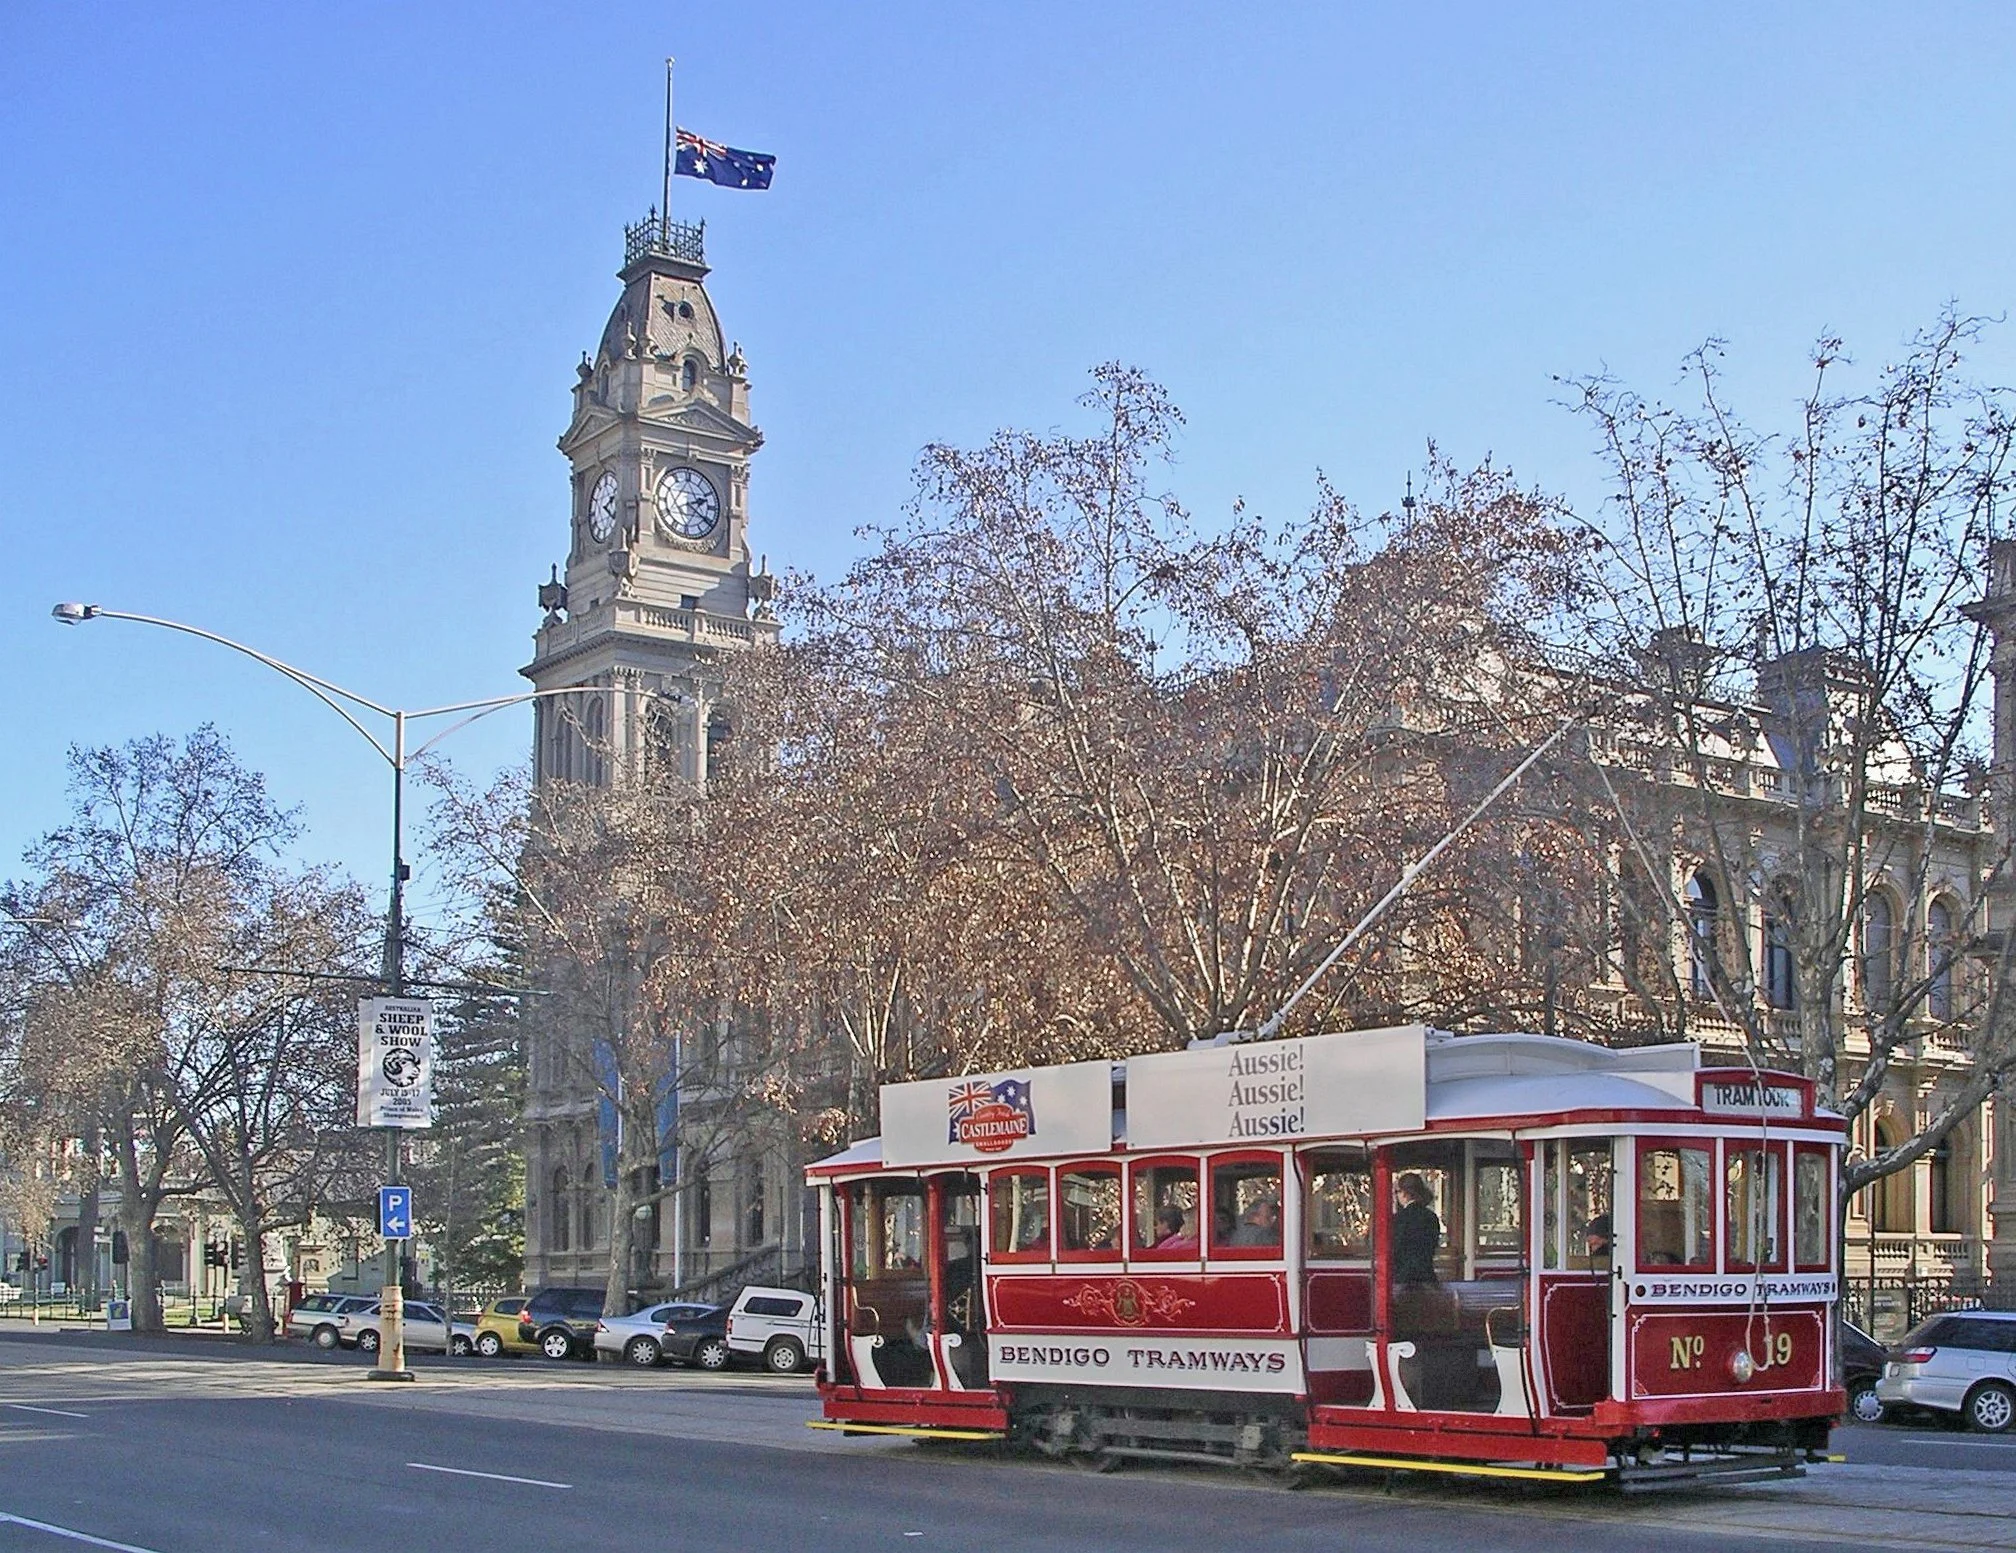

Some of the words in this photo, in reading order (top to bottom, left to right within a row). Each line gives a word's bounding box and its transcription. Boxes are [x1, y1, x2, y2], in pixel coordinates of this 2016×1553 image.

[379, 1013, 424, 1024] SHEEP
[375, 1024, 385, 1034] &
[388, 1025, 428, 1036] WOOL
[380, 1036, 422, 1047] SHOW
[1228, 1044, 1304, 1077] Aussie!
[380, 1088, 400, 1097] JULY
[1228, 1074, 1304, 1107] Aussie!
[961, 1118, 1027, 1140] CASTLEMAINE
[1228, 1106, 1304, 1137] Aussie!
[389, 1195, 402, 1211] P
[1651, 1283, 1747, 1297] BENDIGO
[1755, 1281, 1830, 1297] TRAMWAYS
[1000, 1346, 1110, 1367] BENDIGO
[1127, 1349, 1286, 1373] TRAMWAYS
